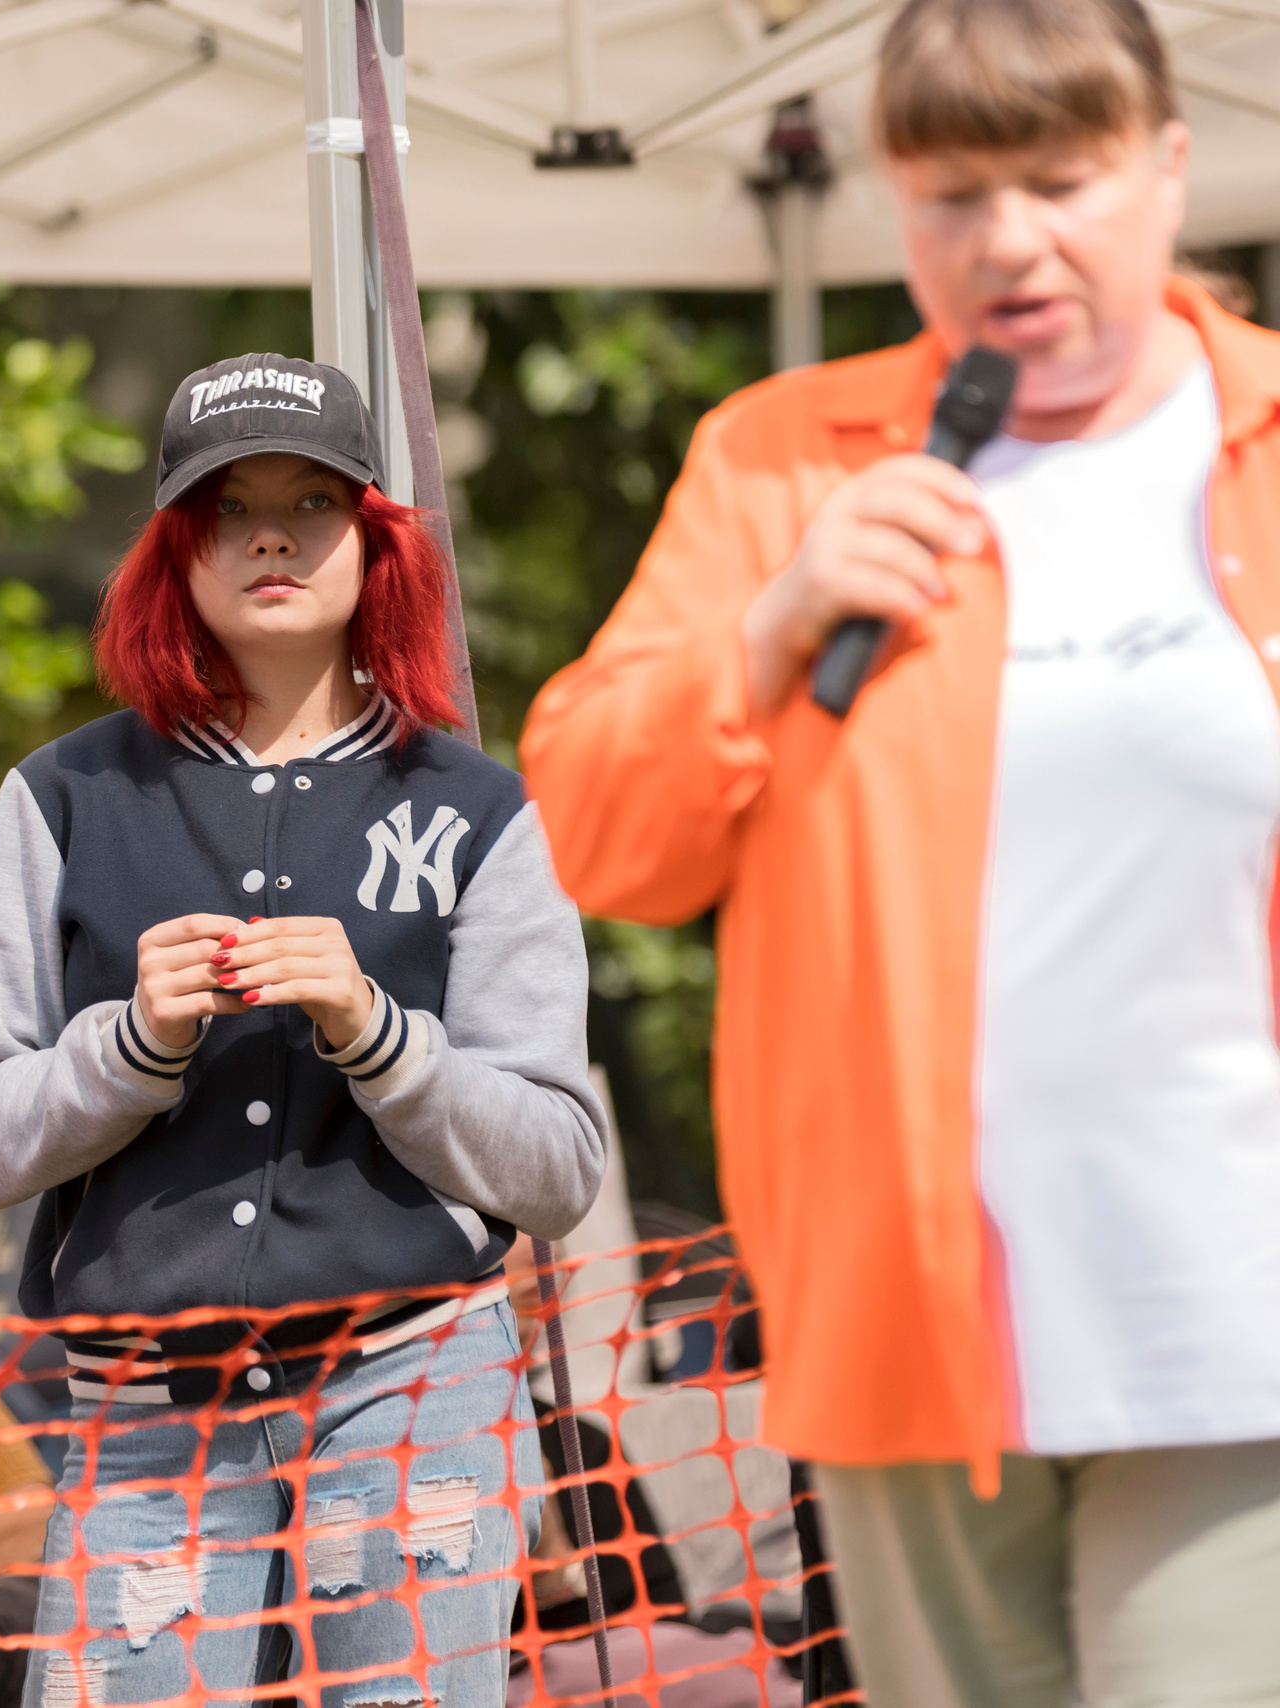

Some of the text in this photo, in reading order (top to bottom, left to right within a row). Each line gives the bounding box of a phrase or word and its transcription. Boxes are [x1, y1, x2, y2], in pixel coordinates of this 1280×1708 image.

[190, 368, 326, 423] THRASHER
[205, 399, 301, 416] MAGAZINE
[357, 799, 471, 918] NY
